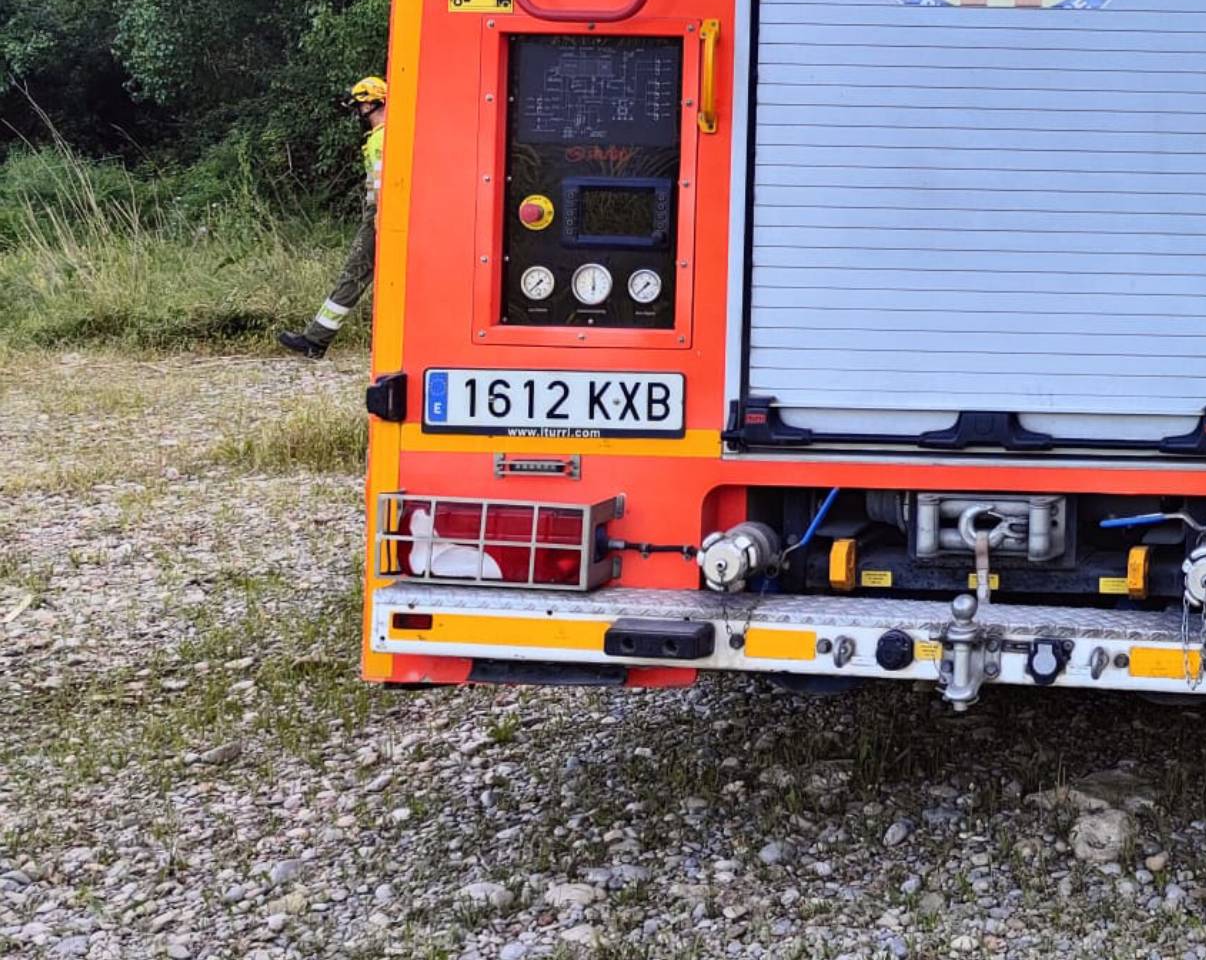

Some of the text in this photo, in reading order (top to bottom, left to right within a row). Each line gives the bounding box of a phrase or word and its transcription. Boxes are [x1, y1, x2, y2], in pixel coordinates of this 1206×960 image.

[464, 377, 671, 422] 1612 KXB
[433, 403, 442, 414] E
[507, 426, 601, 439] www.iturri.com
